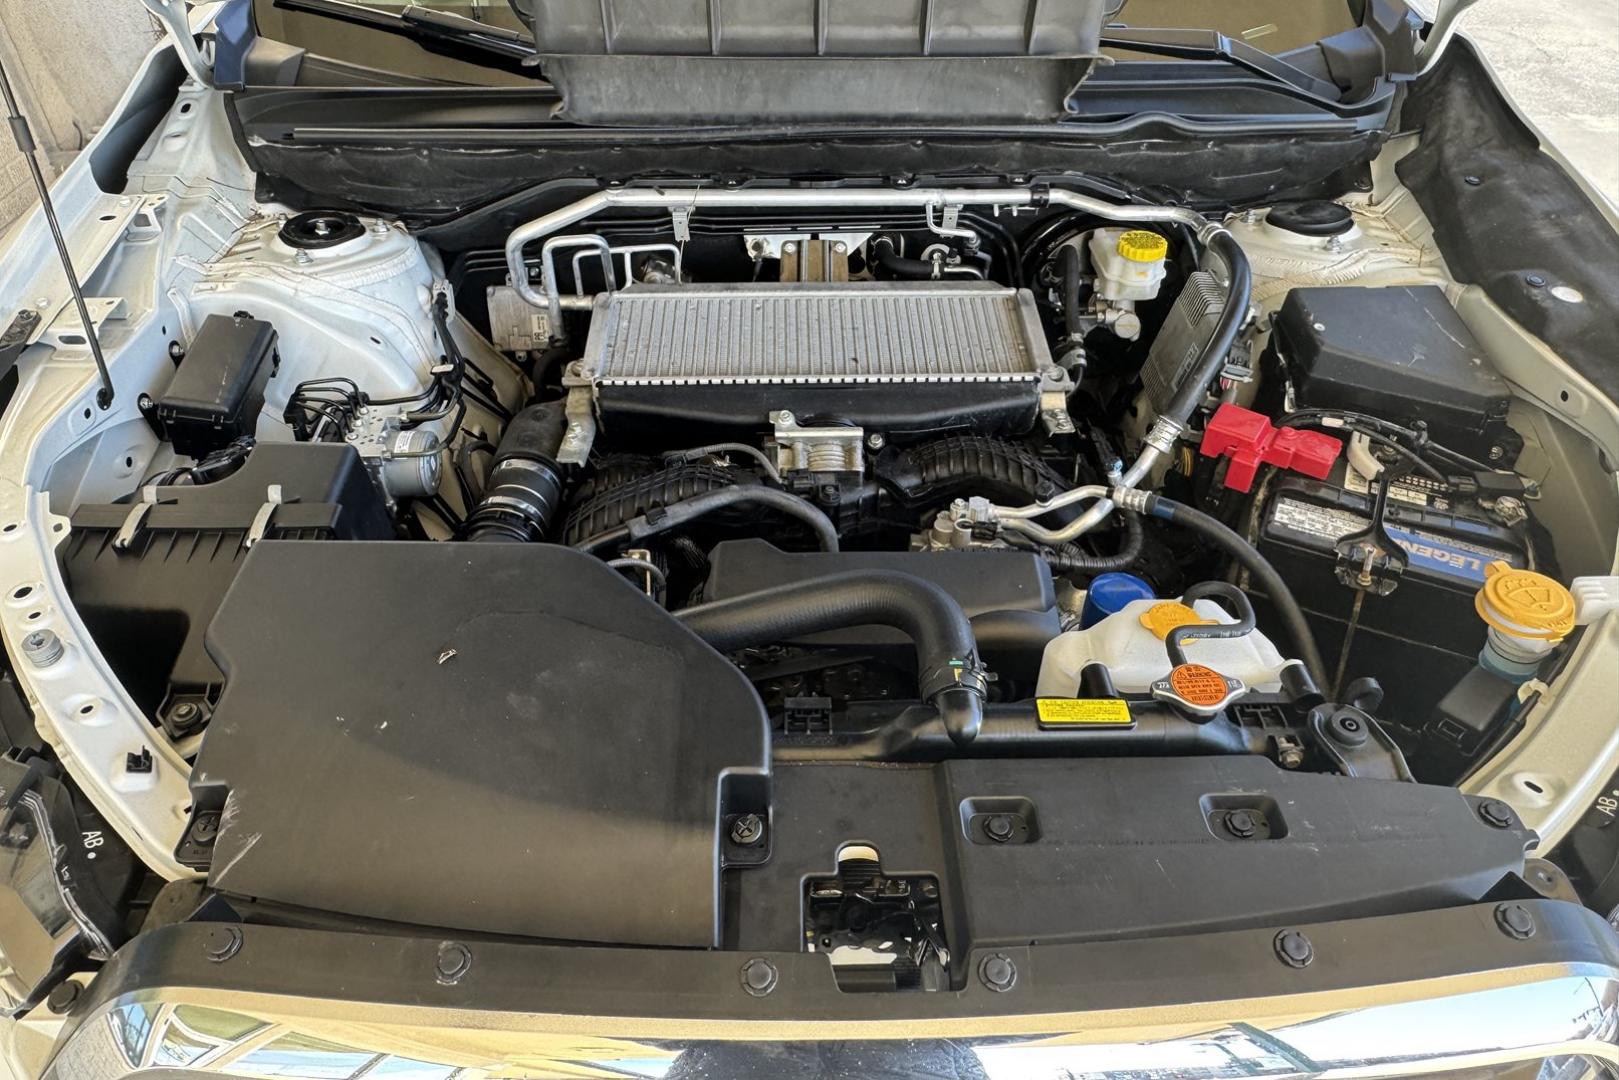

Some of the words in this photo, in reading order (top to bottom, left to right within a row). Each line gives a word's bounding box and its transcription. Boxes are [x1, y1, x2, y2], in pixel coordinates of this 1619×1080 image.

[1395, 539, 1480, 570] LEGEN
[1596, 796, 1618, 817] AB
[81, 831, 105, 849] AB
